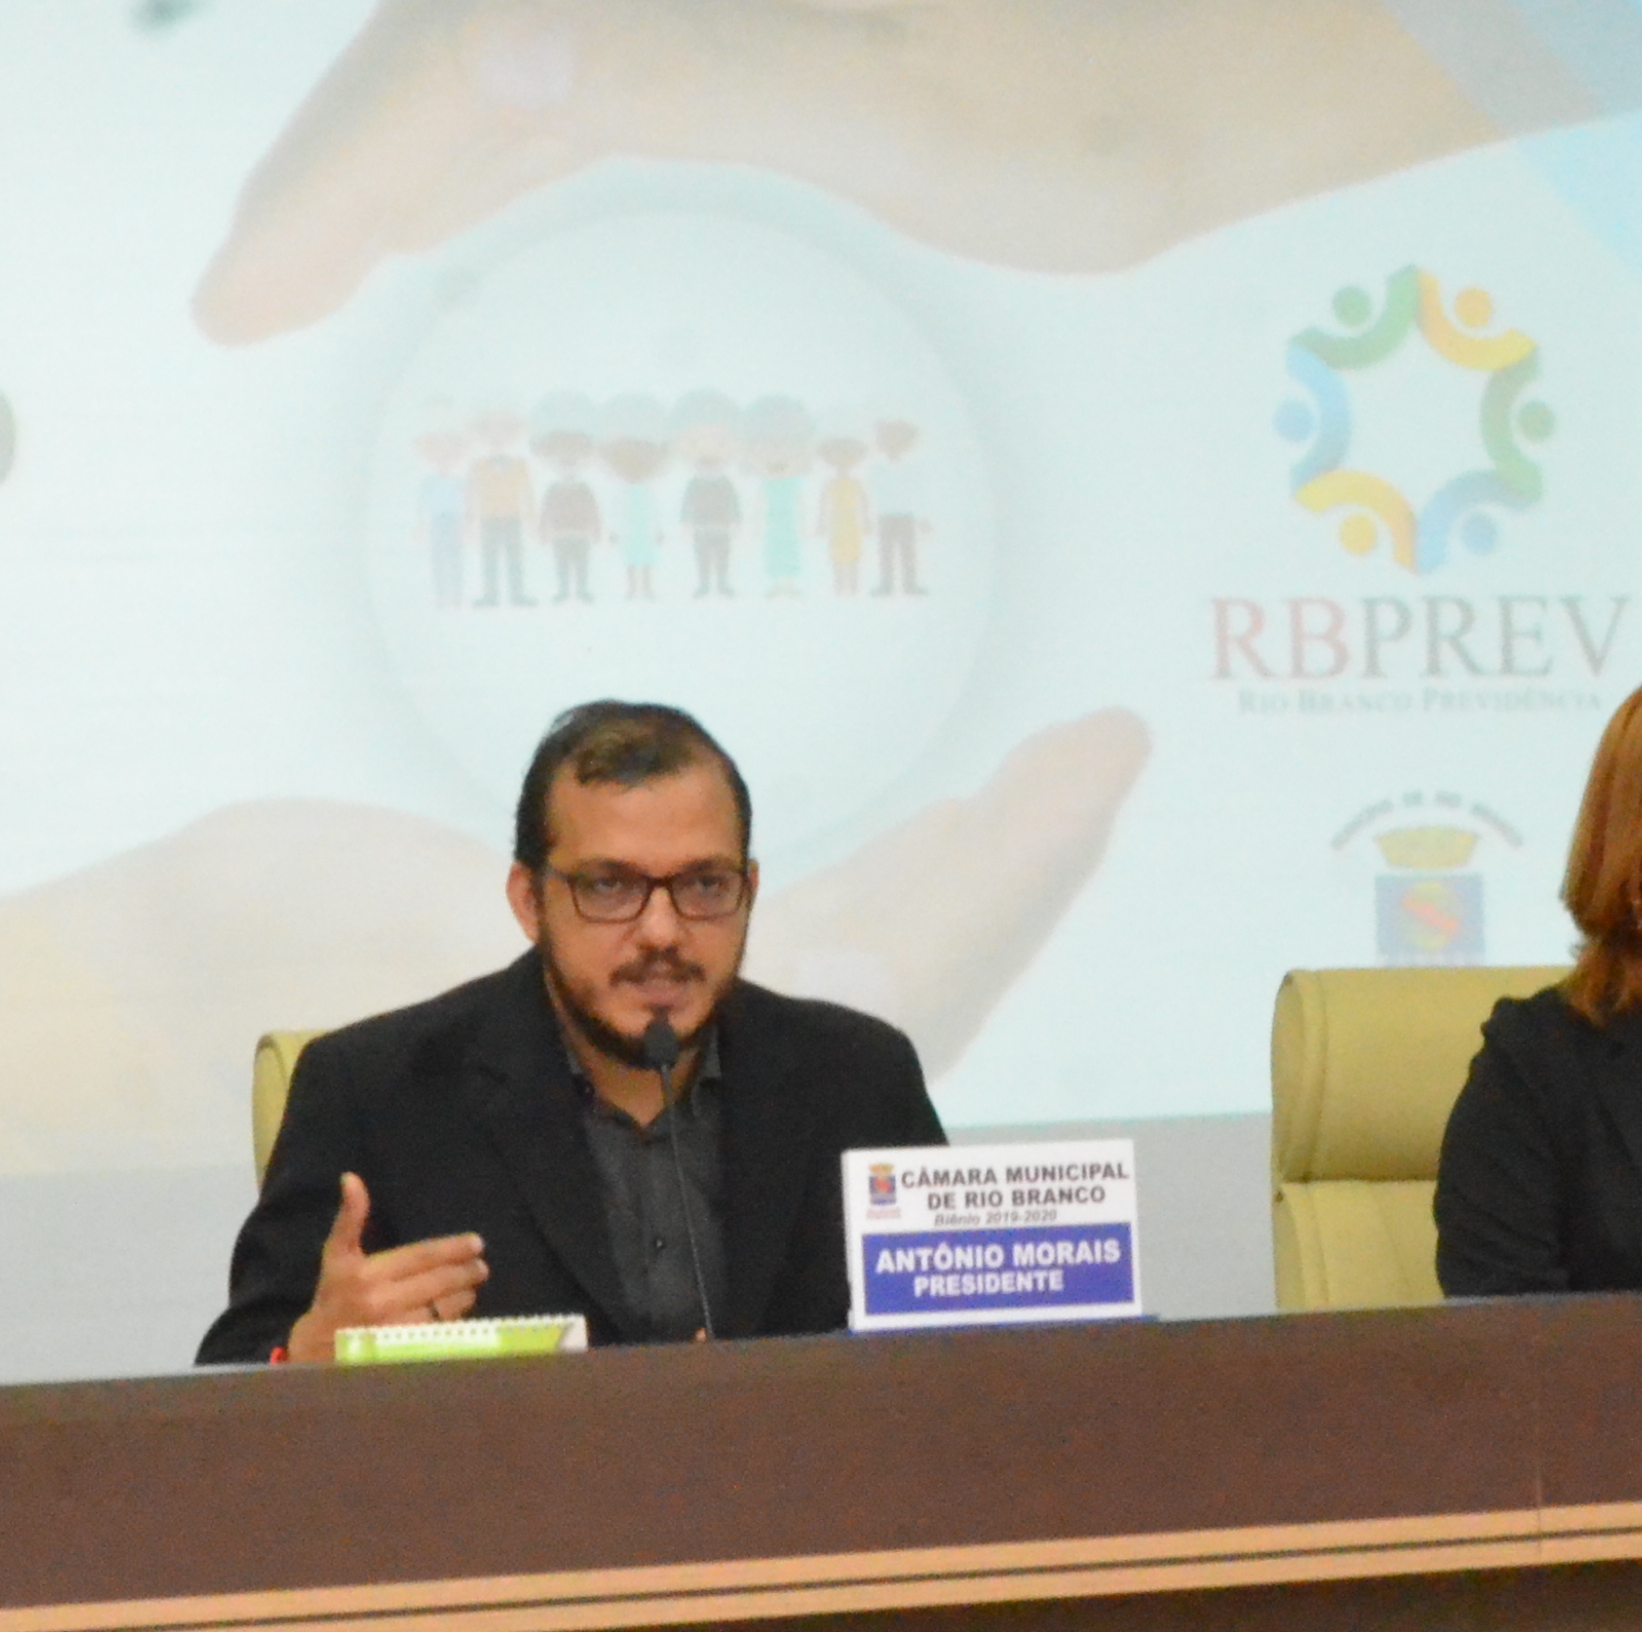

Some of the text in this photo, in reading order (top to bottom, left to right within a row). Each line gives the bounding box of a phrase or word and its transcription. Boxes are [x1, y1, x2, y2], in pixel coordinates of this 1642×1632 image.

[1209, 595, 1630, 680] RBPREV
[901, 1162, 1129, 1189] CÂMARA MUNICIPAL
[927, 1185, 1106, 1210] DE RIO BRANCO
[876, 1239, 1121, 1274] ANTÔNIO MORAIS
[914, 1270, 1064, 1298] PRESIDENTE
